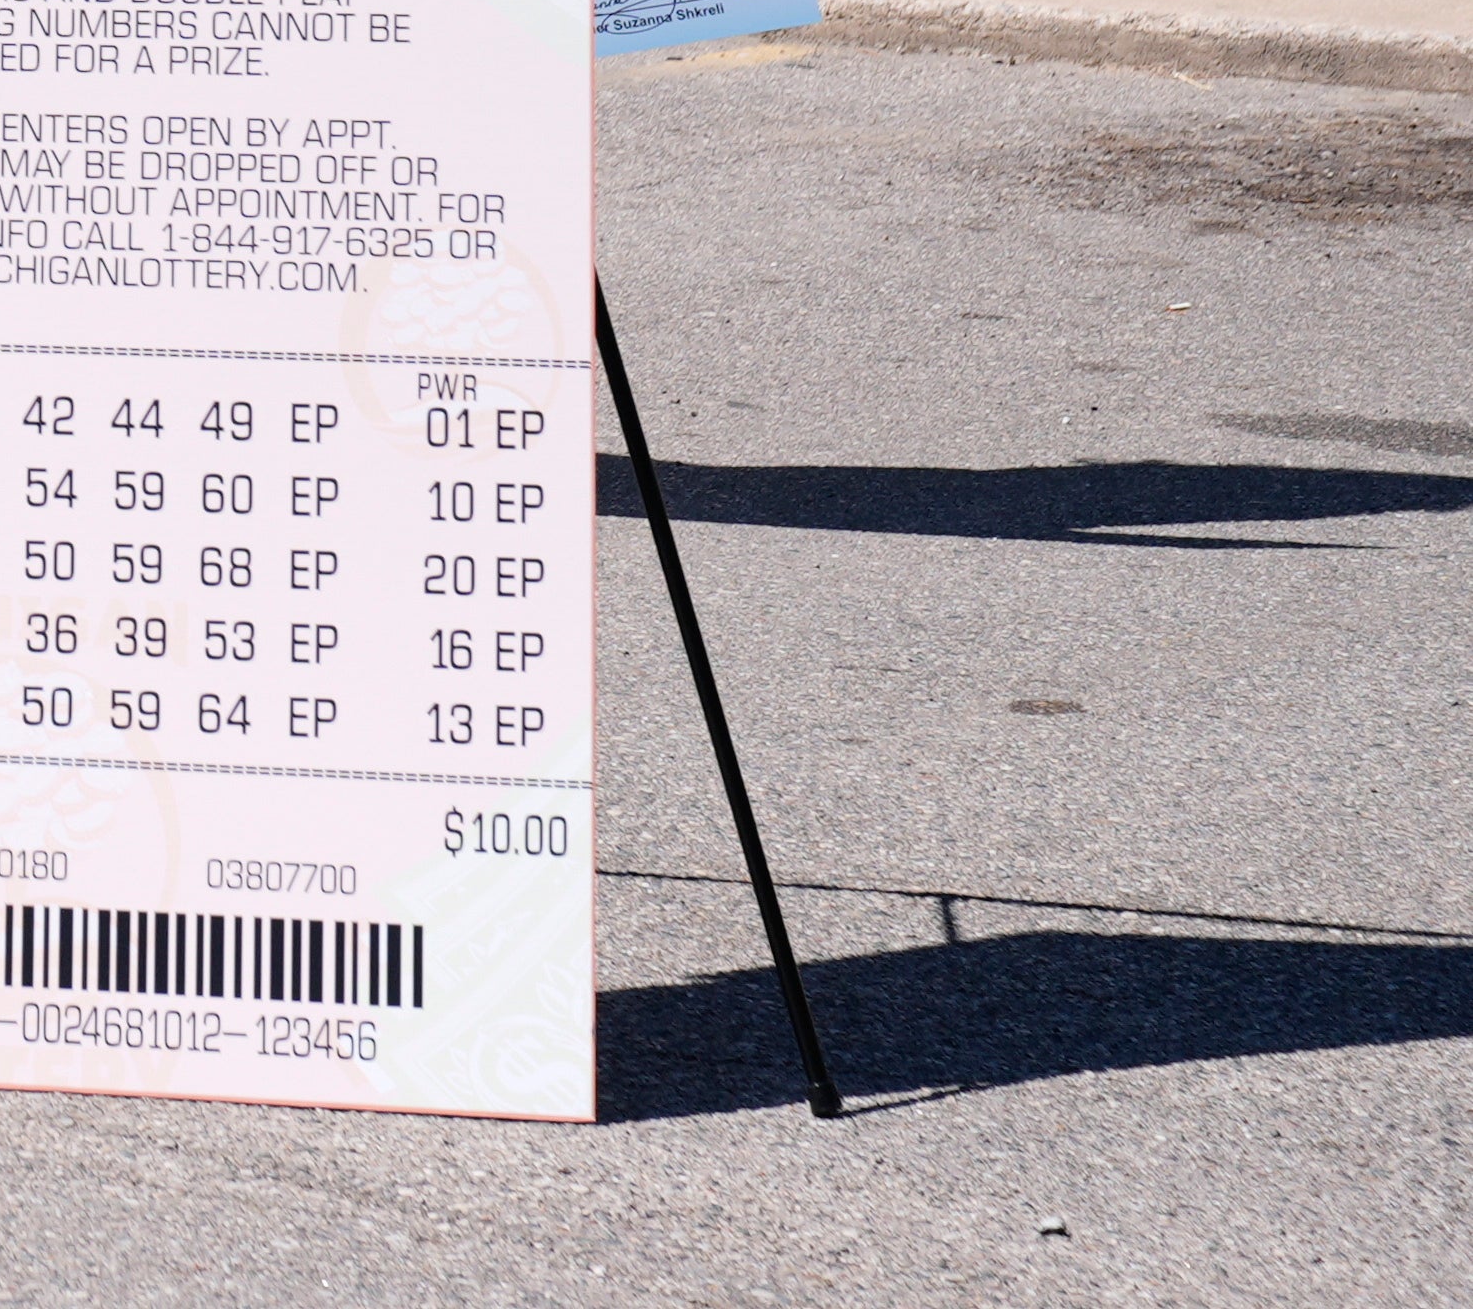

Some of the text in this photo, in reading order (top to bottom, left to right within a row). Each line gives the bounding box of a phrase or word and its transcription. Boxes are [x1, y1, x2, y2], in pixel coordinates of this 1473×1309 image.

[614, 14, 672, 31] Suzanna
[676, 3, 725, 21] Shkreli
[142, 115, 231, 147] OPEN
[246, 117, 289, 147] BY
[302, 119, 392, 150] APPT.
[22, 686, 73, 727] 50
[110, 689, 161, 731] 59
[198, 693, 251, 735] 64
[289, 697, 337, 738] EP
[427, 703, 473, 745] 13
[496, 705, 544, 747] EP
[444, 805, 568, 858] $10.00
